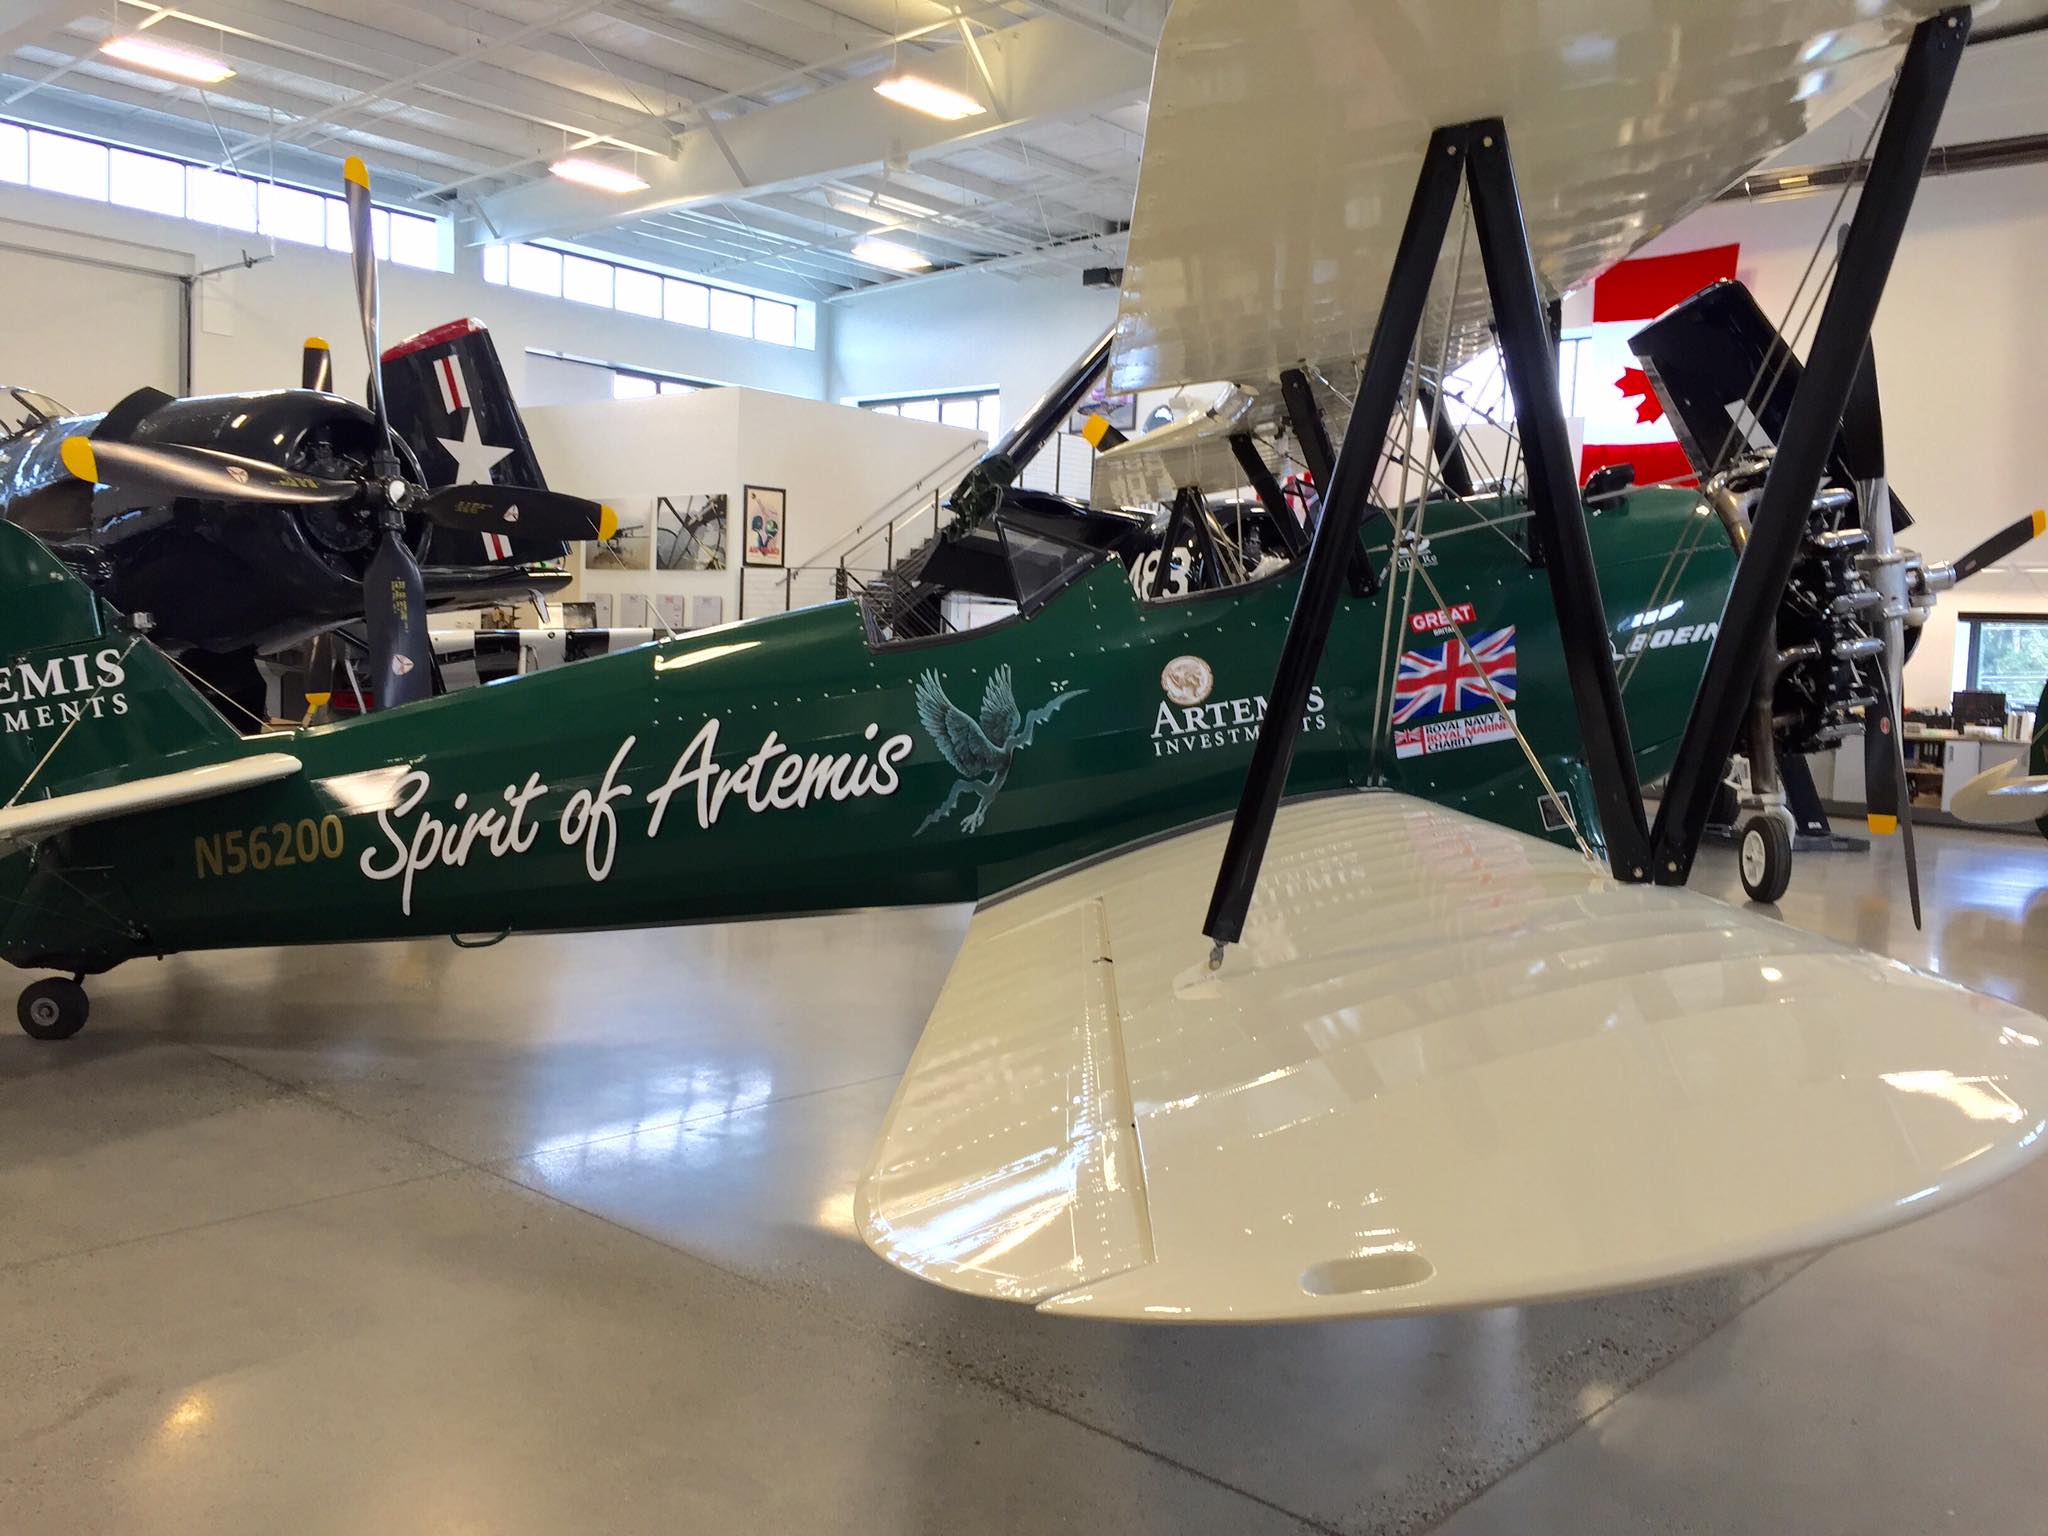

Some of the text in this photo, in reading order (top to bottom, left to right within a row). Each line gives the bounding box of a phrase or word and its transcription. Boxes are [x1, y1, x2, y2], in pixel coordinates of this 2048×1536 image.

[1413, 604, 1471, 630] GREAT
[1630, 621, 1720, 653] BOEIN
[1425, 722, 1460, 734] ROYAL
[1464, 714, 1495, 727] NAVY
[1426, 731, 1461, 744] ROYAL
[1427, 736, 1473, 751] CHARITY
[360, 718, 913, 916] Spirit of Artemis
[195, 814, 344, 879] N56200
